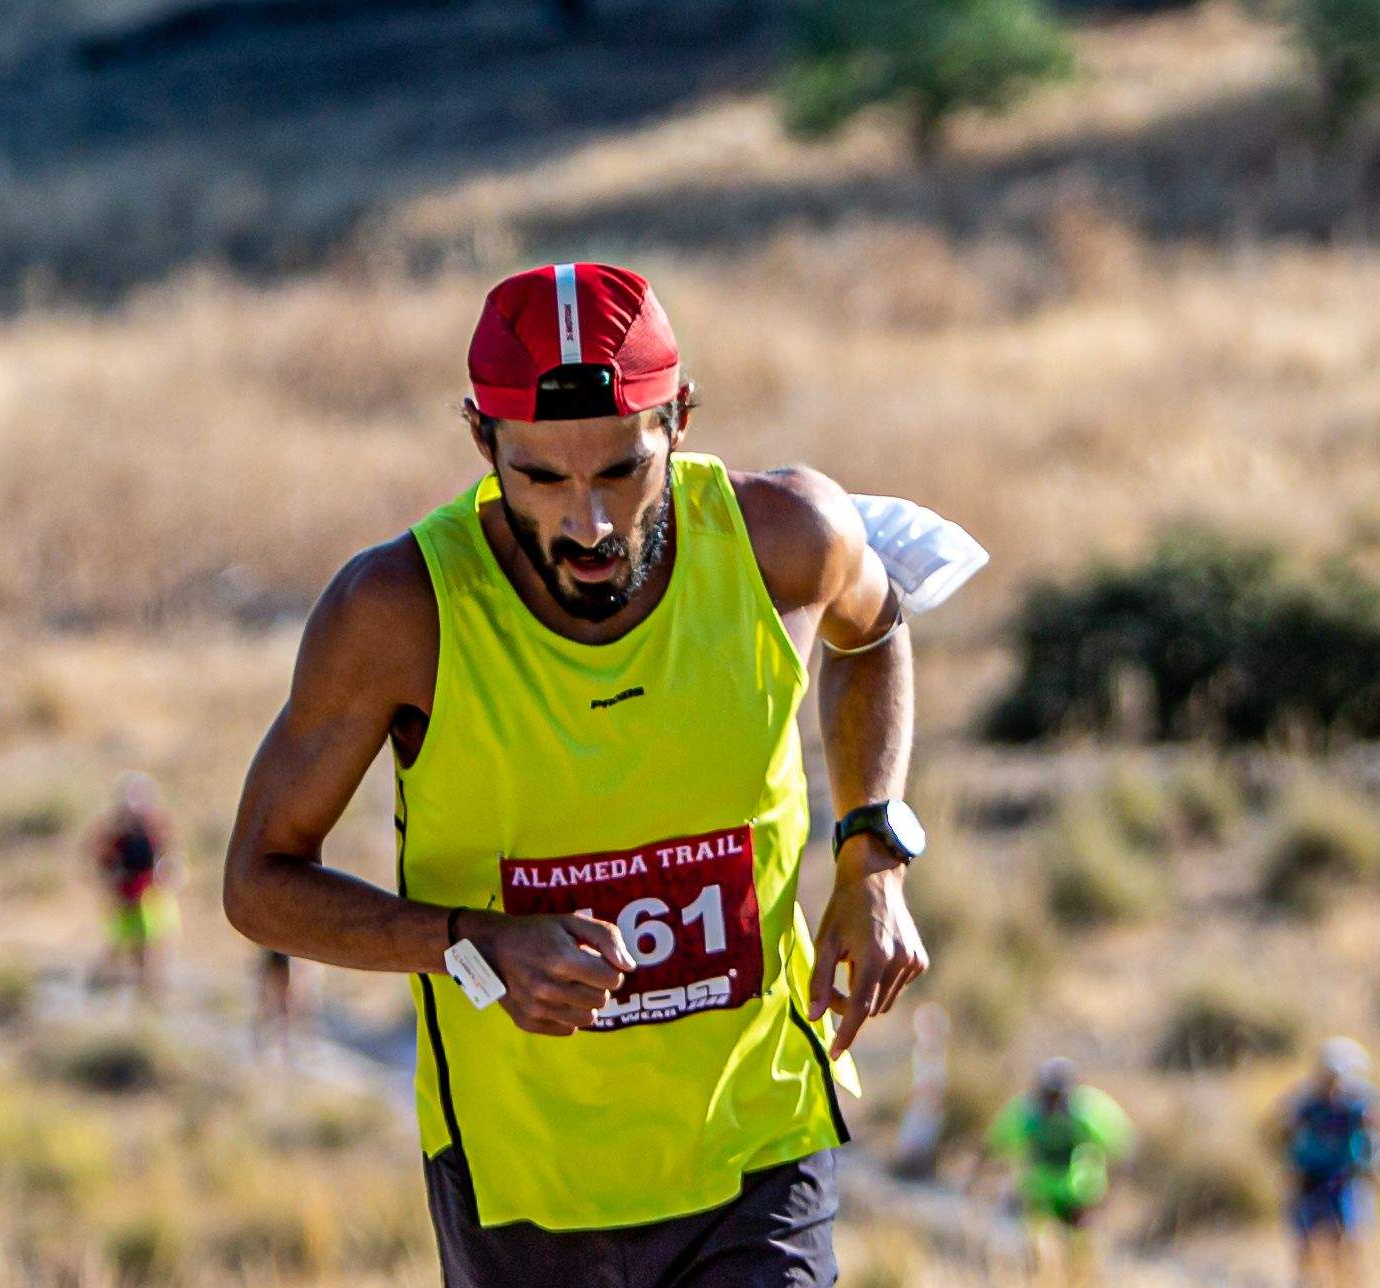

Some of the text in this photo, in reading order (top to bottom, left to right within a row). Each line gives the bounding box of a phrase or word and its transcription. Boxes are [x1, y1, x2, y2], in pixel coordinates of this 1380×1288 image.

[511, 834, 743, 888] ALAMEDA TRAIL
[575, 884, 726, 967] 61
